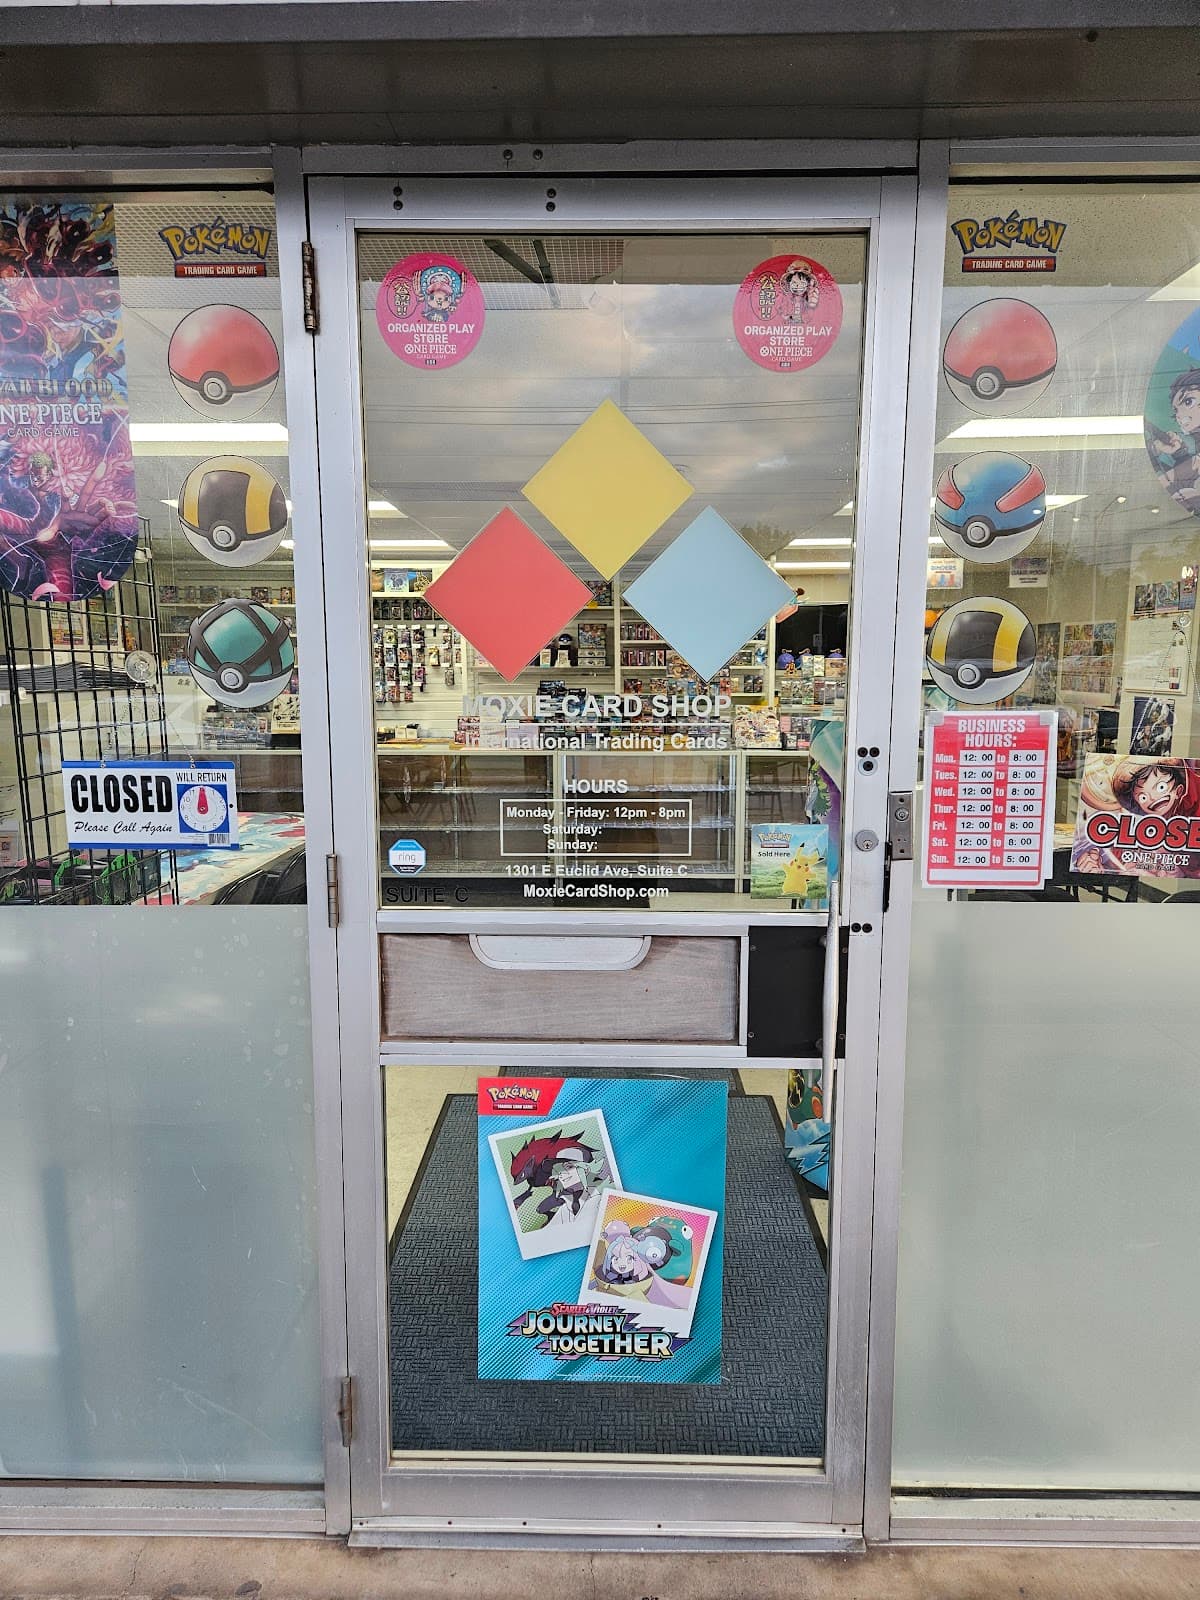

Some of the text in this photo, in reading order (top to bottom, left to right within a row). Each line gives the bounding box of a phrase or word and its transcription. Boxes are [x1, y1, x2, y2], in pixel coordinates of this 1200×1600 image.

[972, 260, 1047, 269] TRADING CARD GAME
[184, 266, 257, 275] TRADING CARD GAME
[387, 323, 475, 333] ORGANIZED PLAY
[744, 325, 832, 336] ORGANIZED PLAY
[413, 334, 448, 343] STORE
[769, 336, 805, 346] STORE
[404, 344, 457, 354] ONE PIECE
[760, 346, 813, 357] ONE PIECE
[37, 403, 103, 425] PIECE
[7, 427, 80, 438] CARD GAME
[463, 695, 732, 718] MOXIE CARD SHOP
[958, 719, 1026, 733] BUSINESS
[592, 732, 664, 752] Trading
[671, 732, 728, 750] Cards
[965, 733, 1017, 748] HOURS:
[935, 754, 956, 763] Mon.
[997, 754, 1006, 763] to
[175, 772, 228, 782] WILL RETURN
[935, 771, 957, 780] Tues.
[996, 771, 1005, 780] to
[564, 779, 628, 794] HOURS
[934, 787, 955, 797] Wed.
[996, 788, 1004, 797] to
[70, 774, 174, 813] CLOSED
[506, 807, 555, 820] Monday
[567, 807, 610, 820] Friday:
[614, 807, 648, 820] 12pm
[659, 807, 686, 820] 8pm
[934, 804, 956, 813] Thur.
[994, 804, 1004, 814] to
[74, 820, 173, 836] Please Call Again
[543, 824, 603, 836] Saturday:
[932, 821, 947, 831] Fri.
[993, 821, 1003, 831] to
[547, 839, 598, 852] Sunday:
[931, 837, 949, 847] Sat.
[992, 838, 1002, 847] to
[398, 852, 416, 863] ring
[931, 854, 949, 863] Sun.
[992, 855, 1001, 864] to
[1121, 851, 1190, 866] ONE PIECE
[505, 864, 688, 878] 1301 E Euclid Ave, Suite C
[386, 886, 469, 903] SUITE C
[523, 884, 669, 900] MoxieCardShop.com
[521, 1310, 627, 1337] JOURNEY
[549, 1333, 674, 1358] TOGETHER
